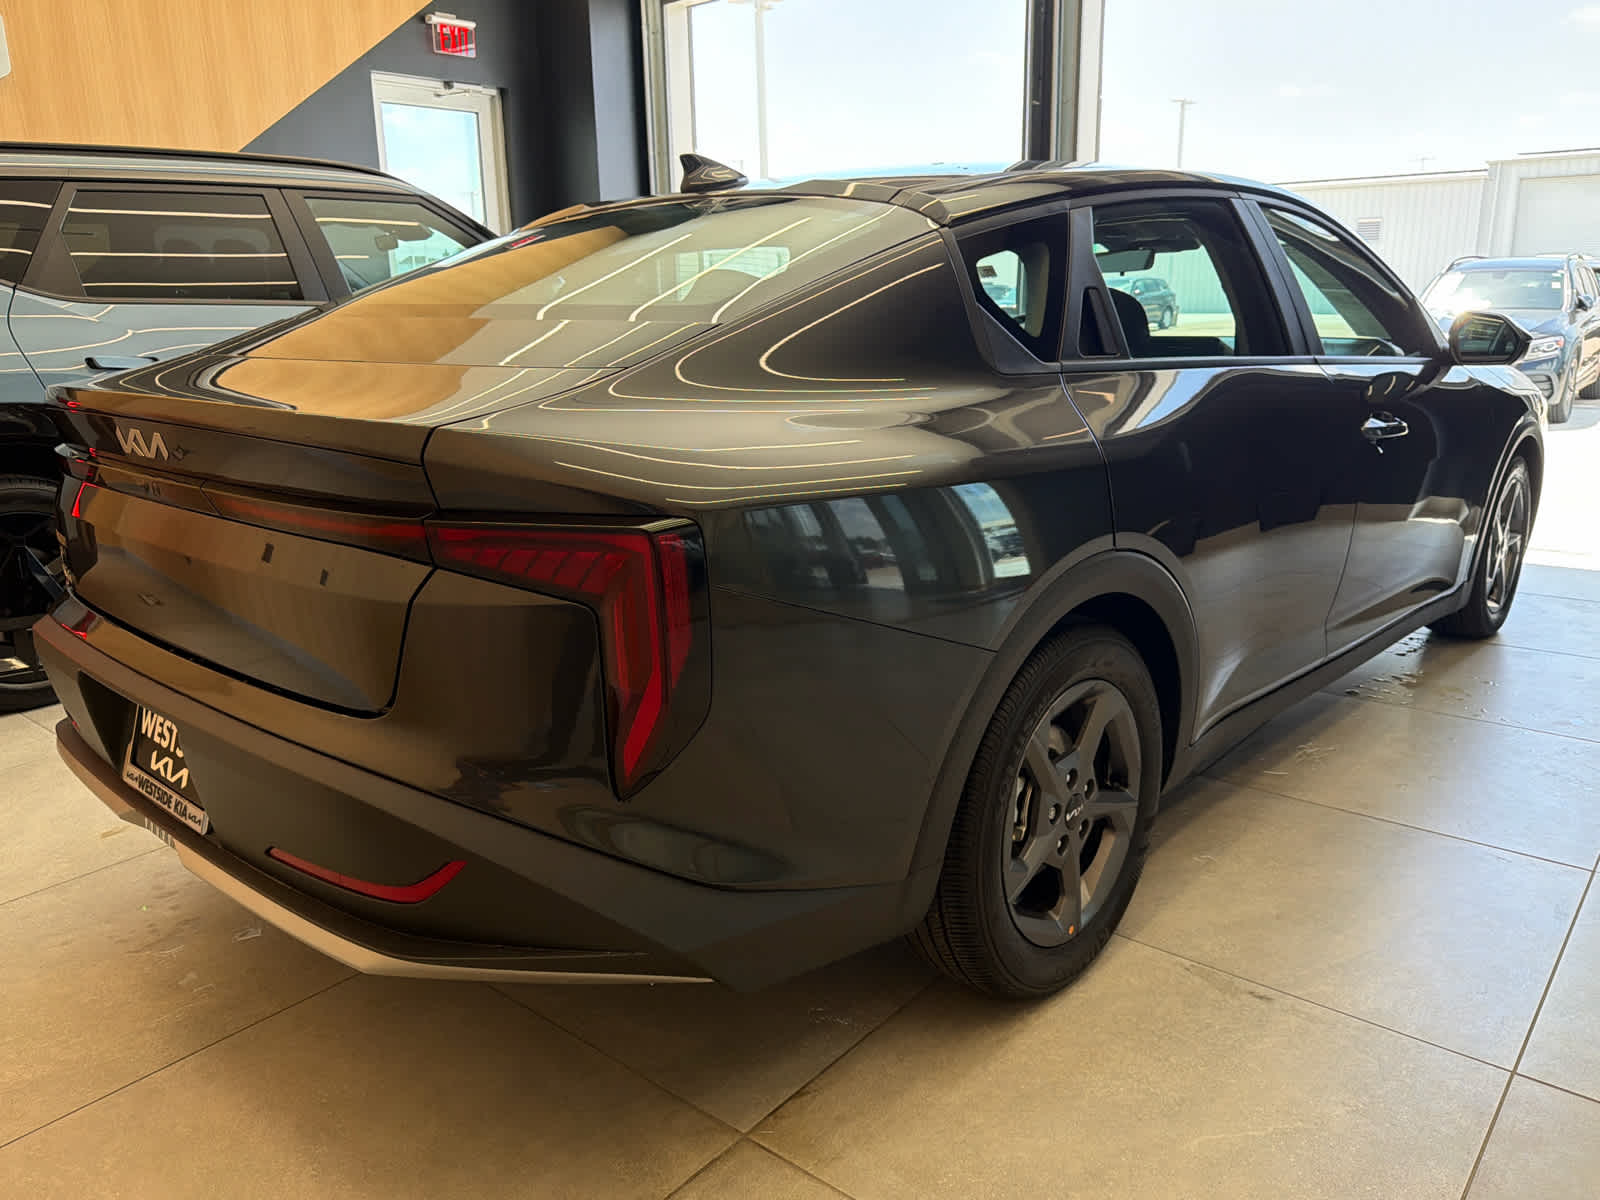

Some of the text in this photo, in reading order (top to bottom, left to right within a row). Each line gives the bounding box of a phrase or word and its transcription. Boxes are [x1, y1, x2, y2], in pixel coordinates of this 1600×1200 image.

[440, 23, 469, 56] EXIT
[115, 425, 169, 461] KIA
[151, 750, 189, 789] KIA
[138, 773, 174, 809] WESTSIDE
[174, 798, 187, 820] KIA
